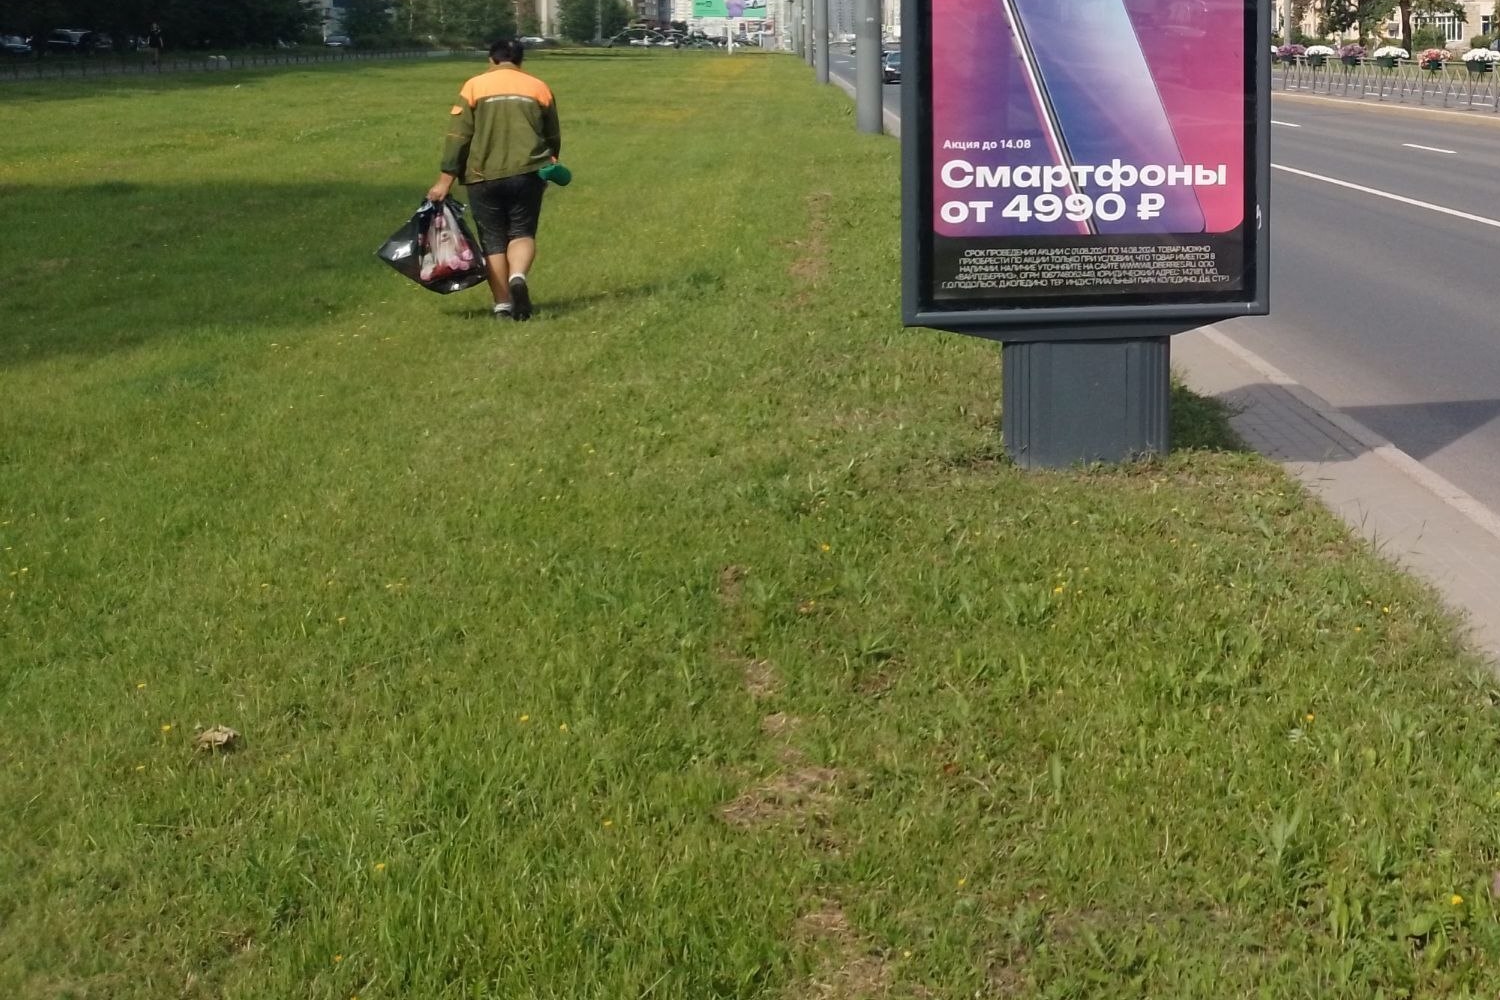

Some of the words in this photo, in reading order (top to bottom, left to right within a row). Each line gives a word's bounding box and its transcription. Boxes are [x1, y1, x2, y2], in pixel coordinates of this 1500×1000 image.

[943, 139, 979, 150] Акция
[982, 140, 997, 150] до
[1000, 139, 1031, 149] 14.08
[941, 159, 1227, 192] Смартфоны
[940, 201, 994, 223] от
[1002, 193, 1126, 222] 4990
[1137, 193, 1165, 220] ₽
[986, 248, 1037, 257] ПРОВЕДЕНИЯ
[1037, 248, 1064, 256] АКЦИИ
[1108, 246, 1119, 254] ПО
[1157, 245, 1181, 253] ТОВАР
[959, 257, 1010, 265] ПРИОБРЕСТИ
[1023, 256, 1049, 264] АКЦИИ
[1051, 255, 1080, 263] ТОЛЬКО
[1001, 264, 1037, 272] НАЛИЧИЕ
[1037, 263, 1082, 271] УТОЧНЯЙТЕ
[1094, 262, 1119, 270] САЙТЕ
